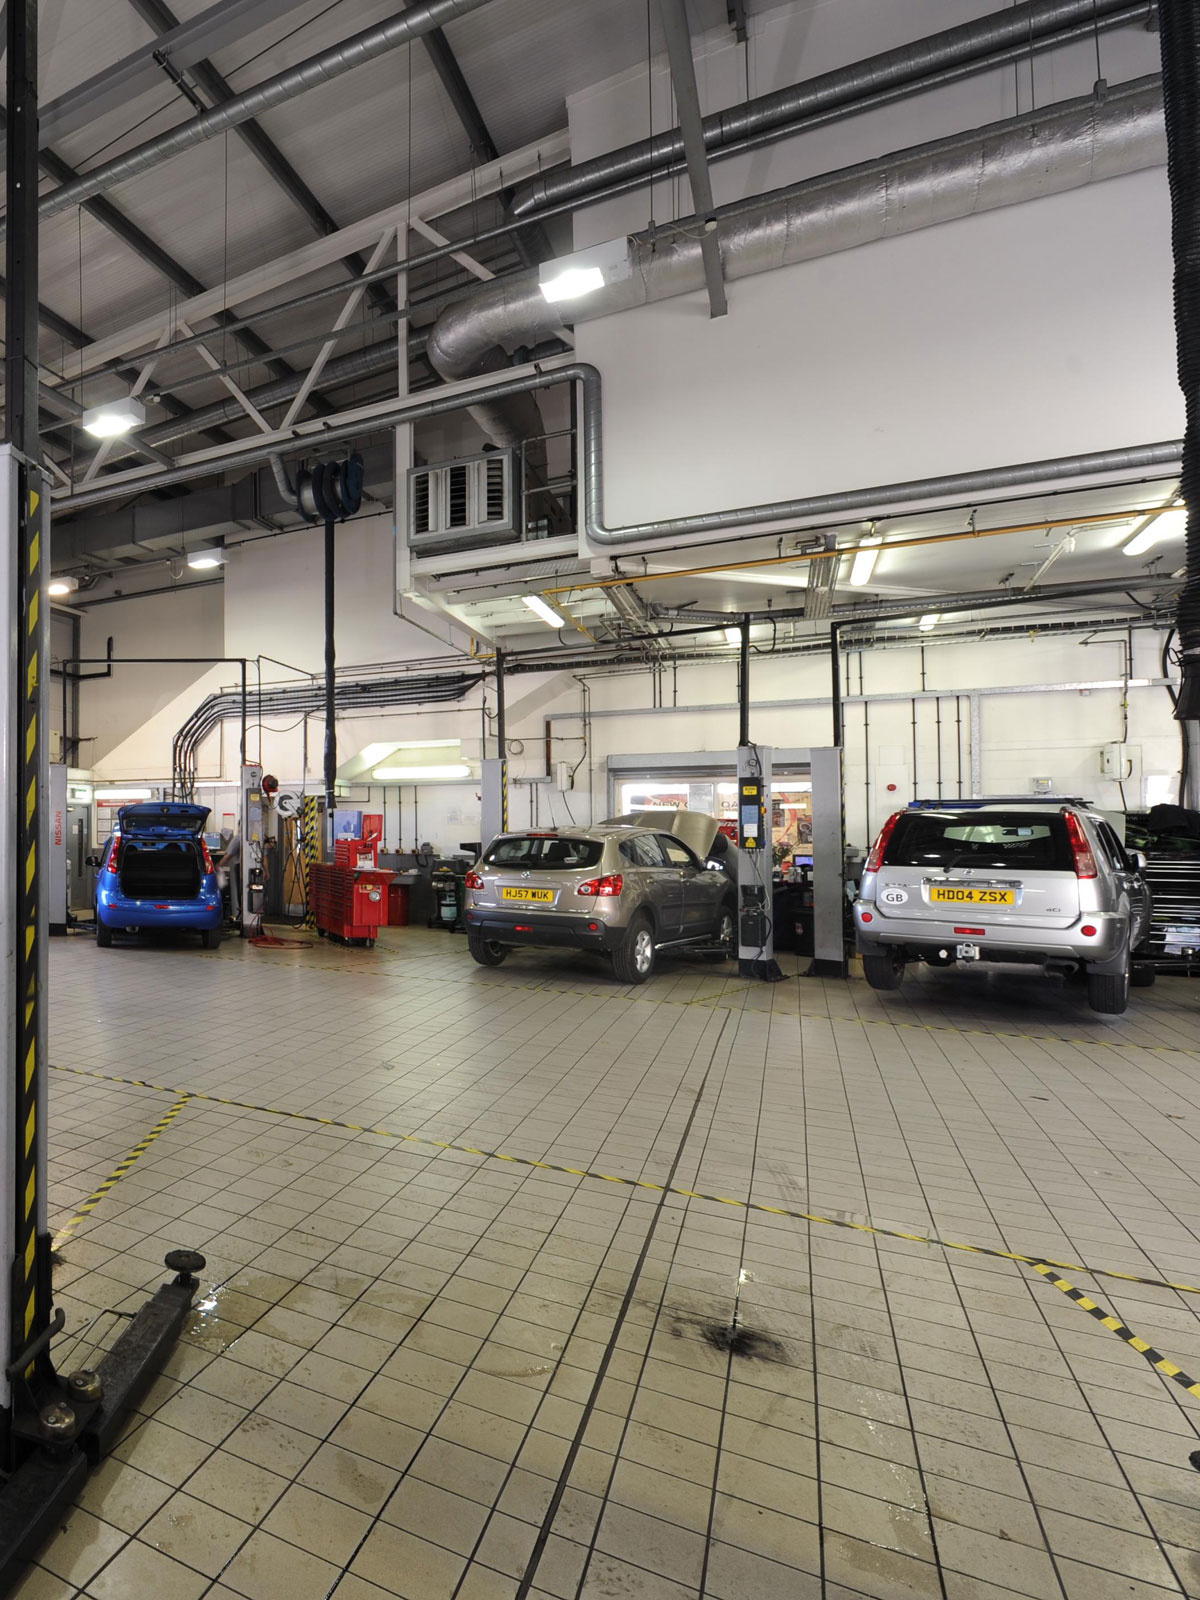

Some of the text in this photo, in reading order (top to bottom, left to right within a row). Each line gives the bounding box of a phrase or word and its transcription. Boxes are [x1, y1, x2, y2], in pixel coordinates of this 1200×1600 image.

[505, 889, 529, 898] HJ57
[886, 893, 903, 902] GB
[937, 889, 1008, 902] HD04 ZSX
